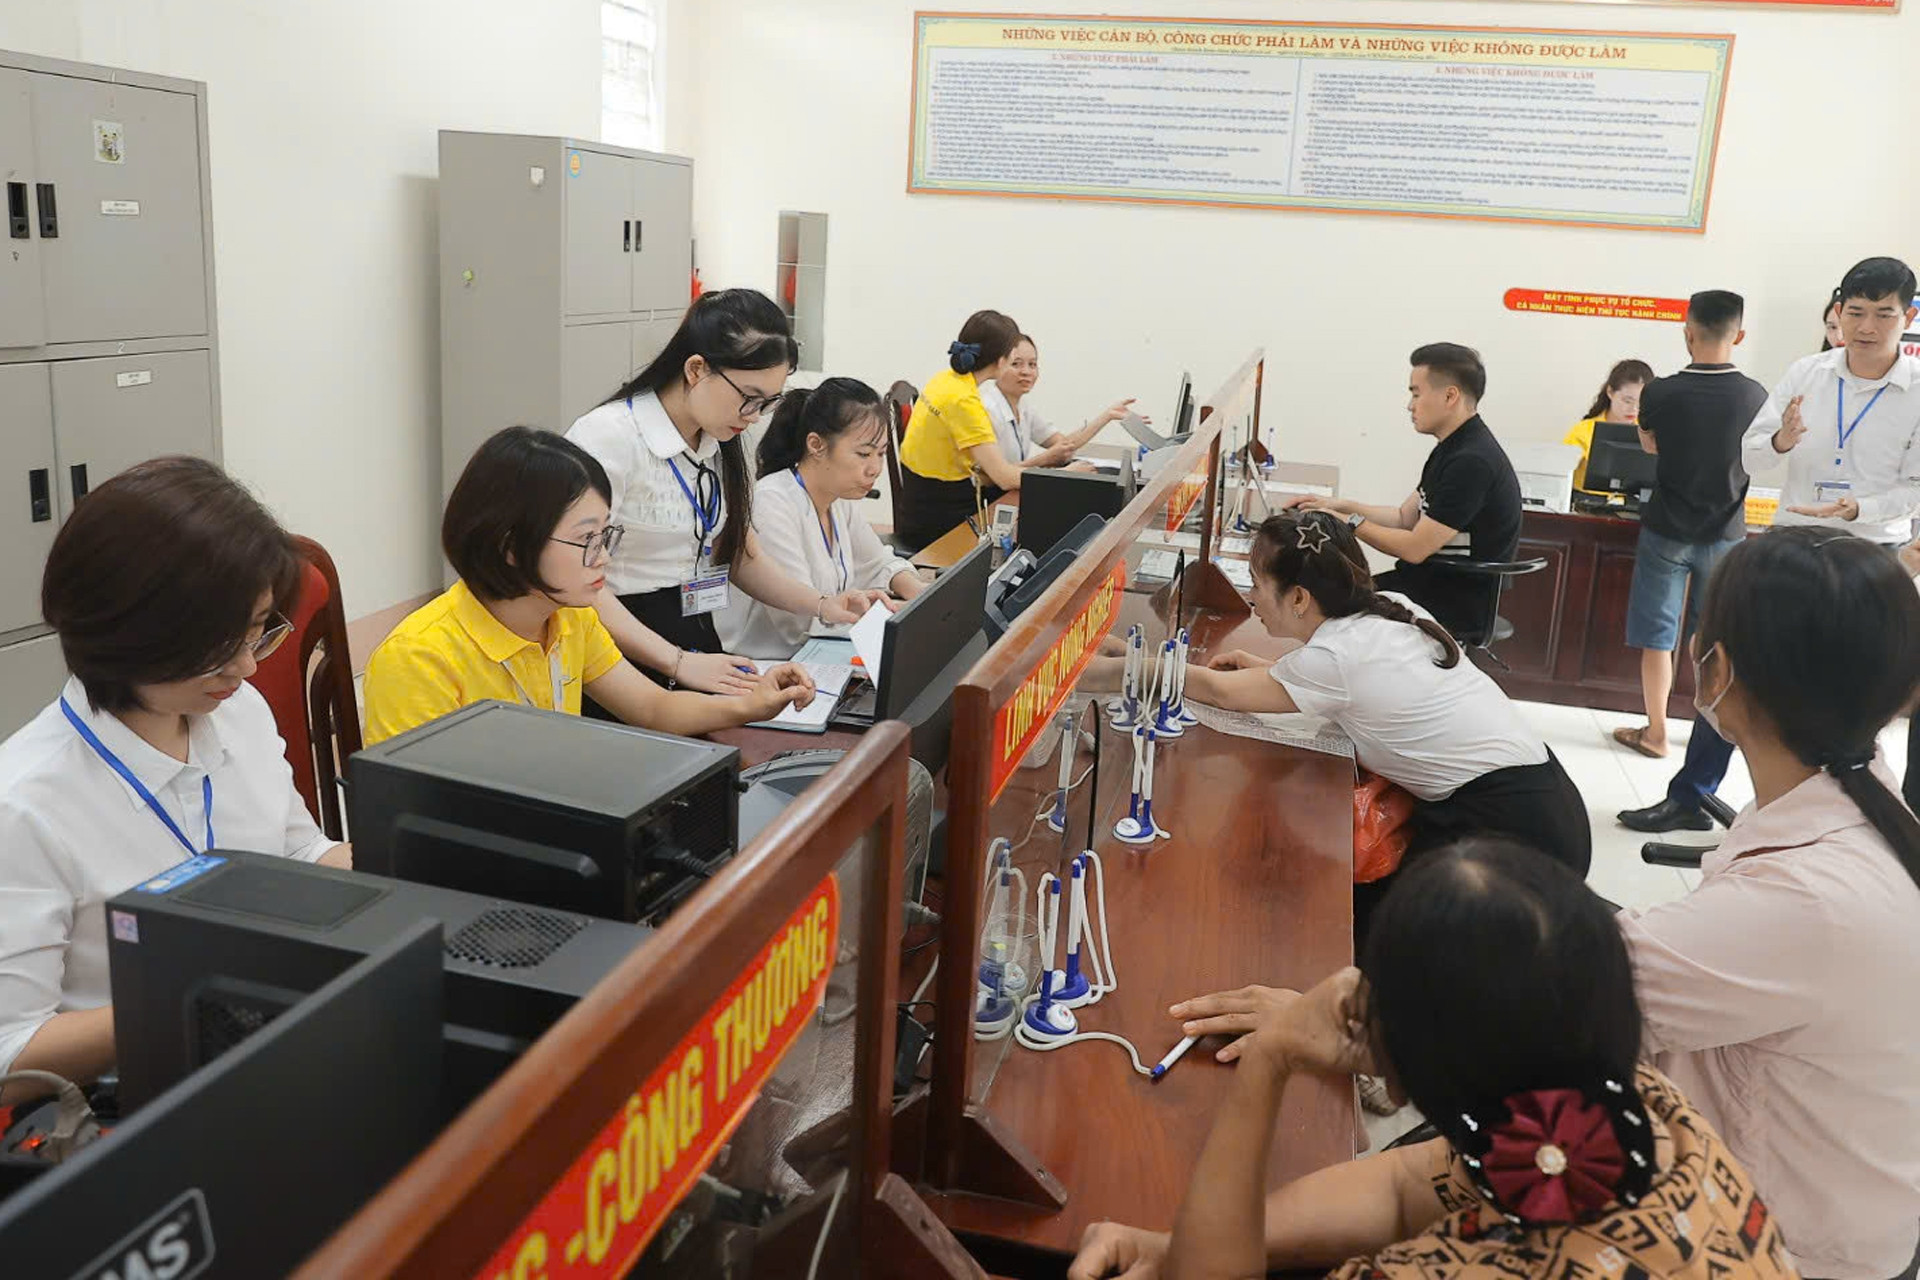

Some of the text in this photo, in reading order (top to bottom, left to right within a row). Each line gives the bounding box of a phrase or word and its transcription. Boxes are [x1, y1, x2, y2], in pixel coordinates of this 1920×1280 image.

[1002, 27, 1056, 41] NHỮNG
[1061, 28, 1097, 43] VIỆC
[1164, 31, 1206, 45] CÔNG
[1210, 32, 1252, 46] CHỨC
[1256, 32, 1294, 48] PHẢI
[1300, 34, 1334, 49] LÀM
[1340, 36, 1361, 49] VÀ
[1367, 38, 1425, 52] NHỮNG
[1430, 39, 1469, 55] VIỆC
[1474, 40, 1533, 55] KHÔNG
[1540, 44, 1585, 59] ĐƯỢC
[1589, 43, 1627, 59] LÀM
[1004, 674, 1036, 763] LĨNH
[1037, 647, 1059, 717] VỰC
[714, 896, 828, 1102] THƯƠNG
